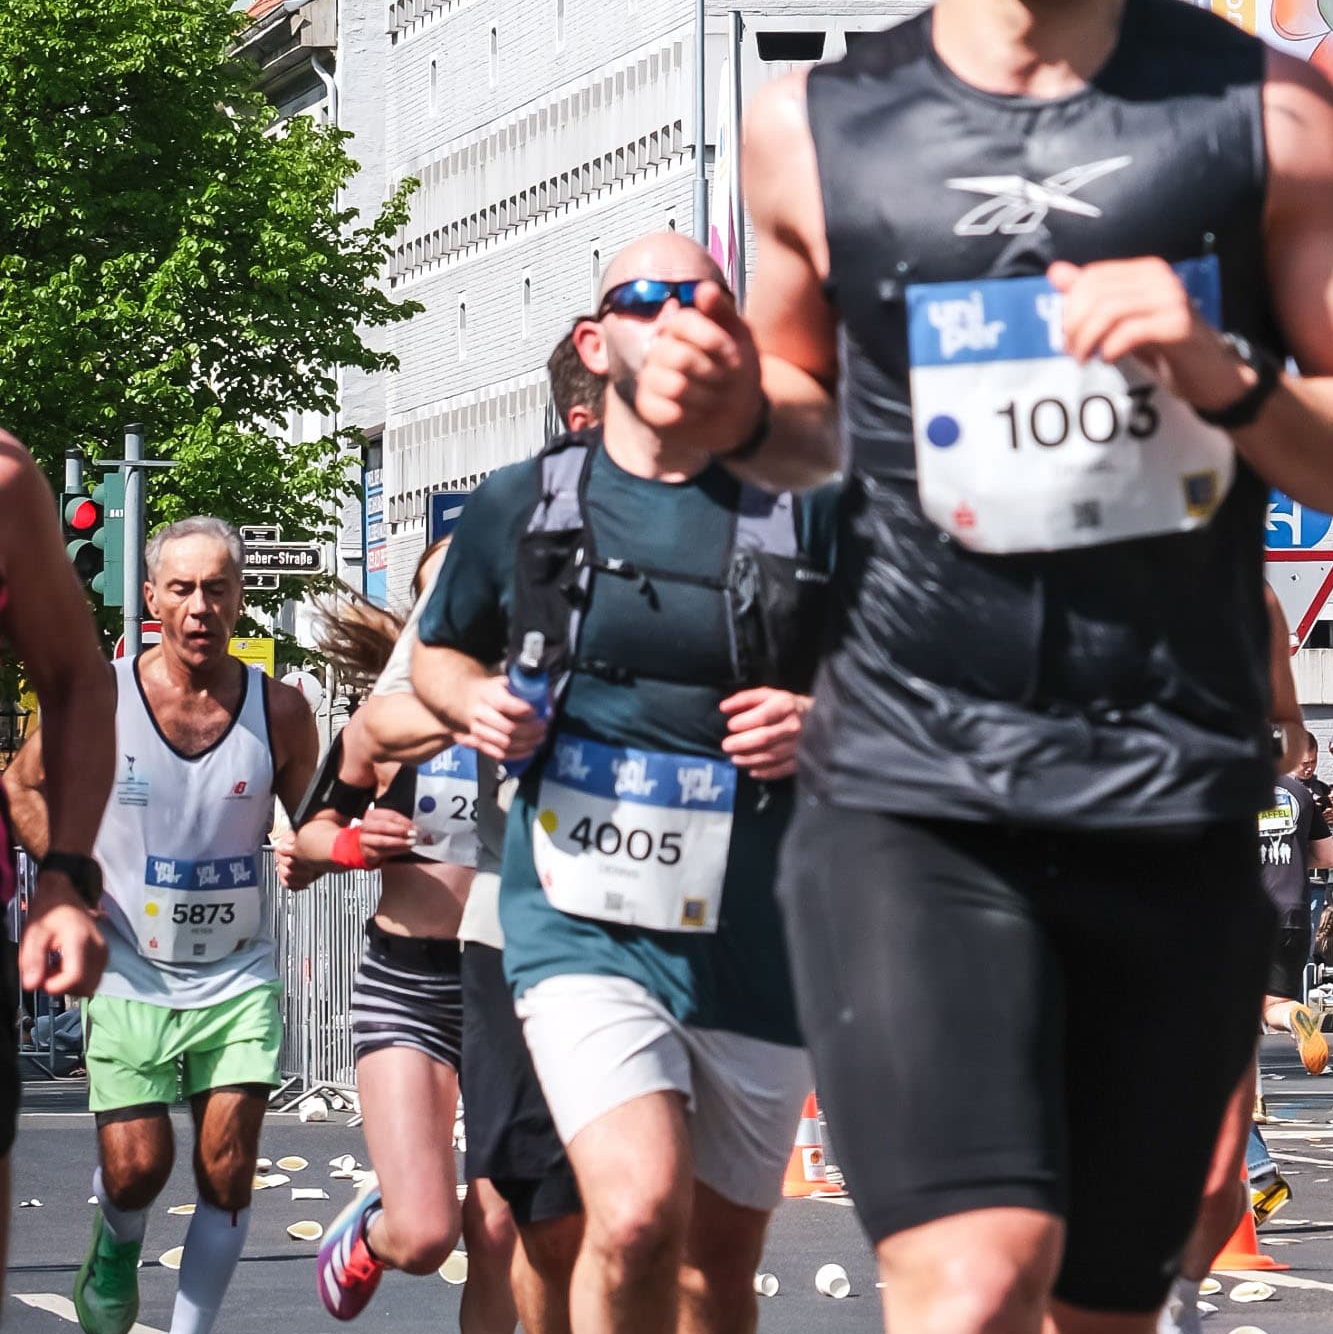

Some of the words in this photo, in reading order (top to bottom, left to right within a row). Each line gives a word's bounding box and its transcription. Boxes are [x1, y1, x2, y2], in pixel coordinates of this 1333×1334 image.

[995, 383, 1161, 451] 1003
[256, 576, 264, 586] 2
[568, 815, 683, 866] 4005
[171, 902, 236, 925] 5873
